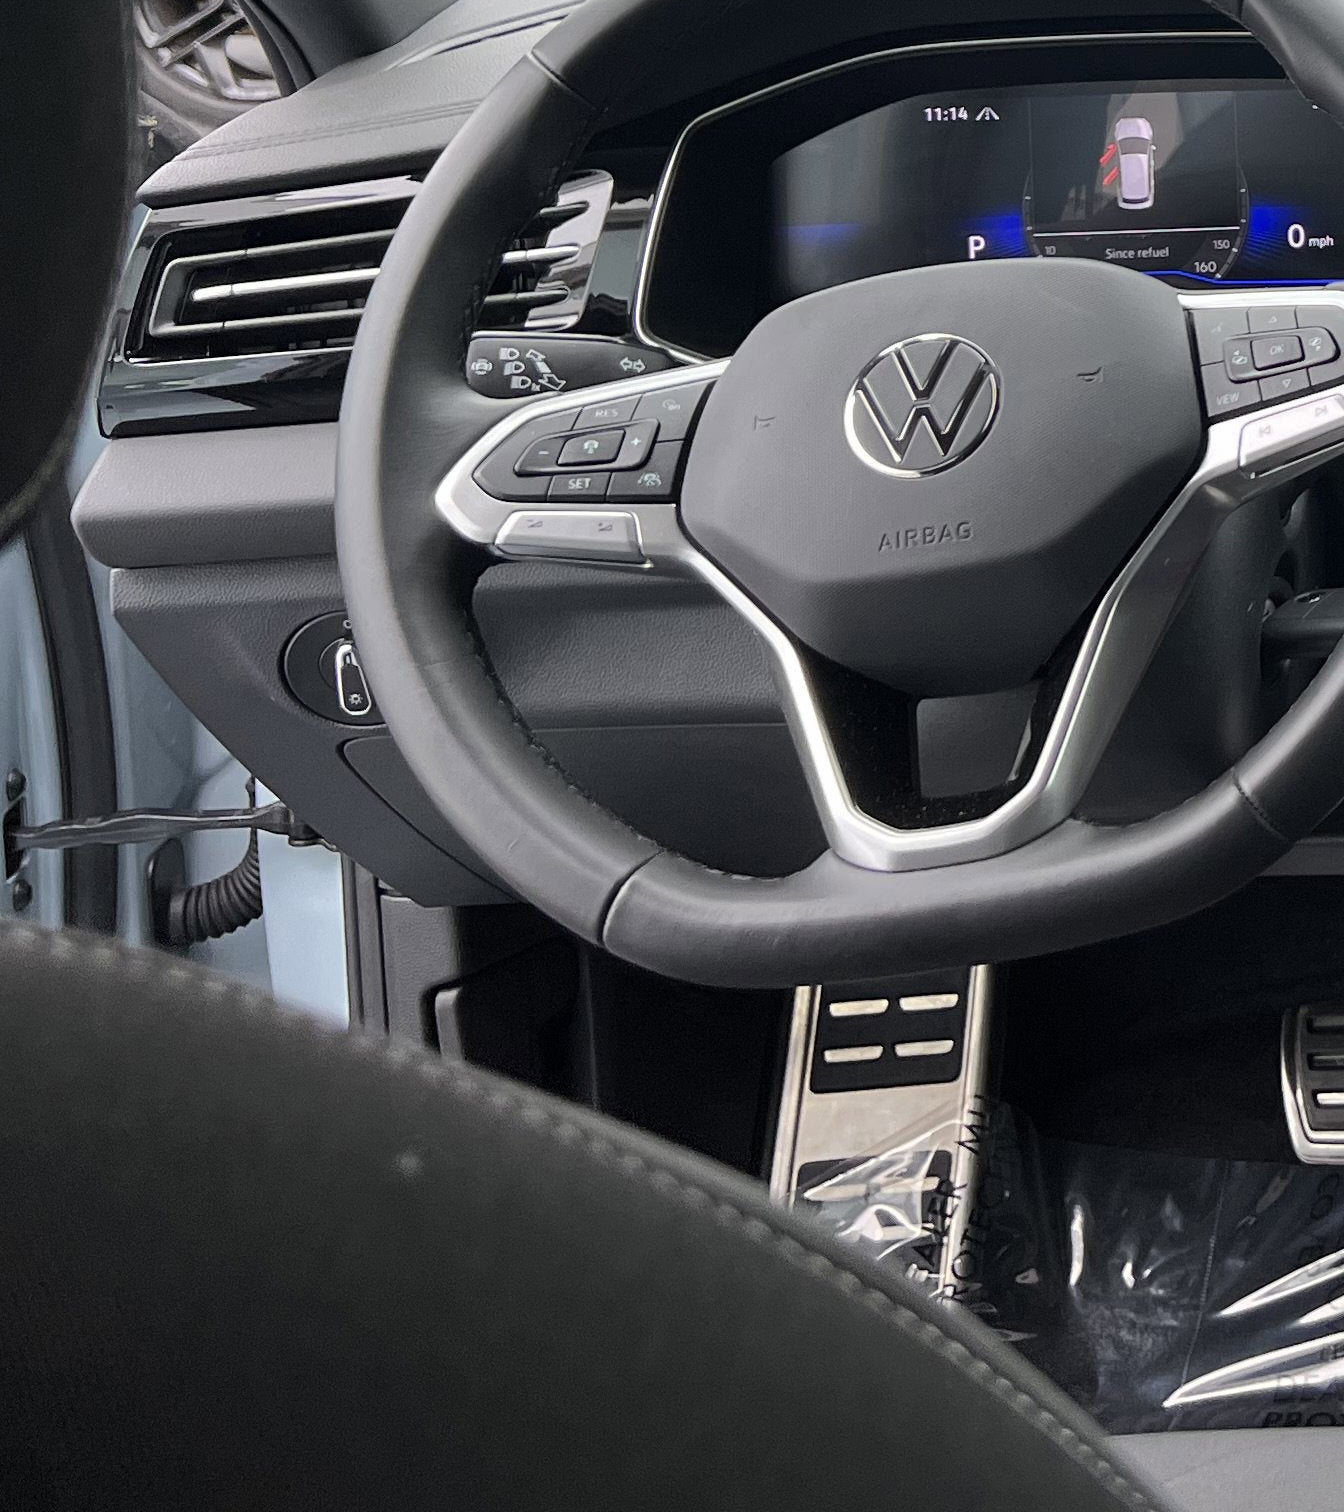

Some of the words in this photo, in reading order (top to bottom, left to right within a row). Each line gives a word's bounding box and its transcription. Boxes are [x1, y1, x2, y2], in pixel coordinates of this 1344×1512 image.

[924, 106, 969, 122] 11:14
[1286, 223, 1305, 249] 0
[1308, 234, 1335, 249] mph
[967, 235, 986, 259] P
[1212, 239, 1231, 250] 150
[1105, 247, 1136, 260] Since
[1137, 246, 1170, 259] refuel
[1194, 260, 1217, 273] 160
[1216, 390, 1241, 407] VIEW
[594, 407, 619, 419] RES
[567, 477, 592, 490] SET
[877, 520, 974, 553] AIRBAG
